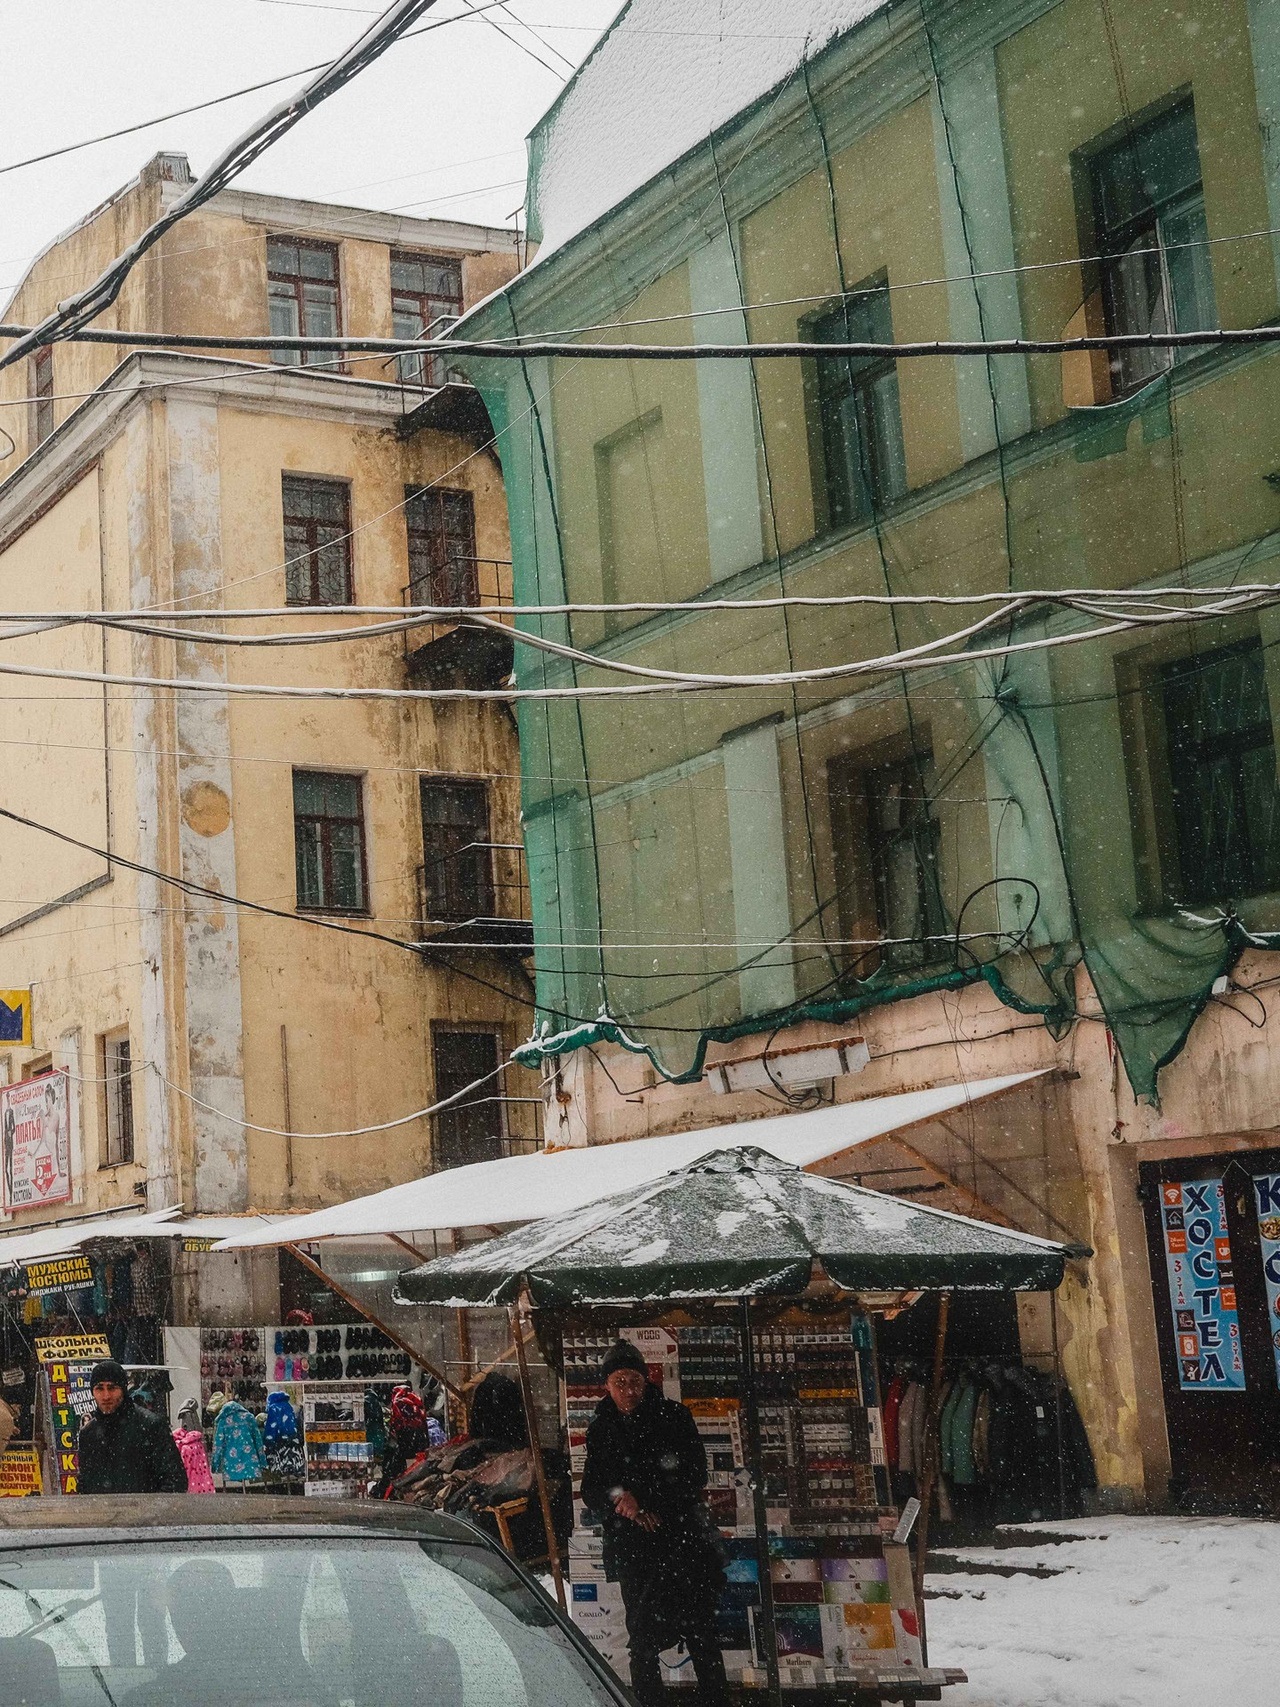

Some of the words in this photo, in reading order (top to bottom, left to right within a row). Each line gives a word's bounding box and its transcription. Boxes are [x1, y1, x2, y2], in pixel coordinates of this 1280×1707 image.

[16, 1117, 42, 1146] ПЛАТЬЯ
[185, 1243, 212, 1252] ОБУВ
[27, 1256, 90, 1278] МУЖСКИЕ
[1174, 1260, 1182, 1273] 3
[28, 1268, 93, 1289] КОСТЮМЫ
[1183, 1184, 1227, 1382] ХОСТЕЛ
[30, 1286, 63, 1297] ПИДЖАКИ
[1176, 1277, 1186, 1305] ЭТАЖ
[1229, 1324, 1238, 1338] 3
[35, 1336, 107, 1349] ШКОЛЬНАЯ
[43, 1347, 105, 1359] ФОРМА
[1231, 1341, 1243, 1371] ЭТАЖ
[67, 1390, 92, 1405] НИЗКИ
[1, 1463, 36, 1472] ЕМОНТ
